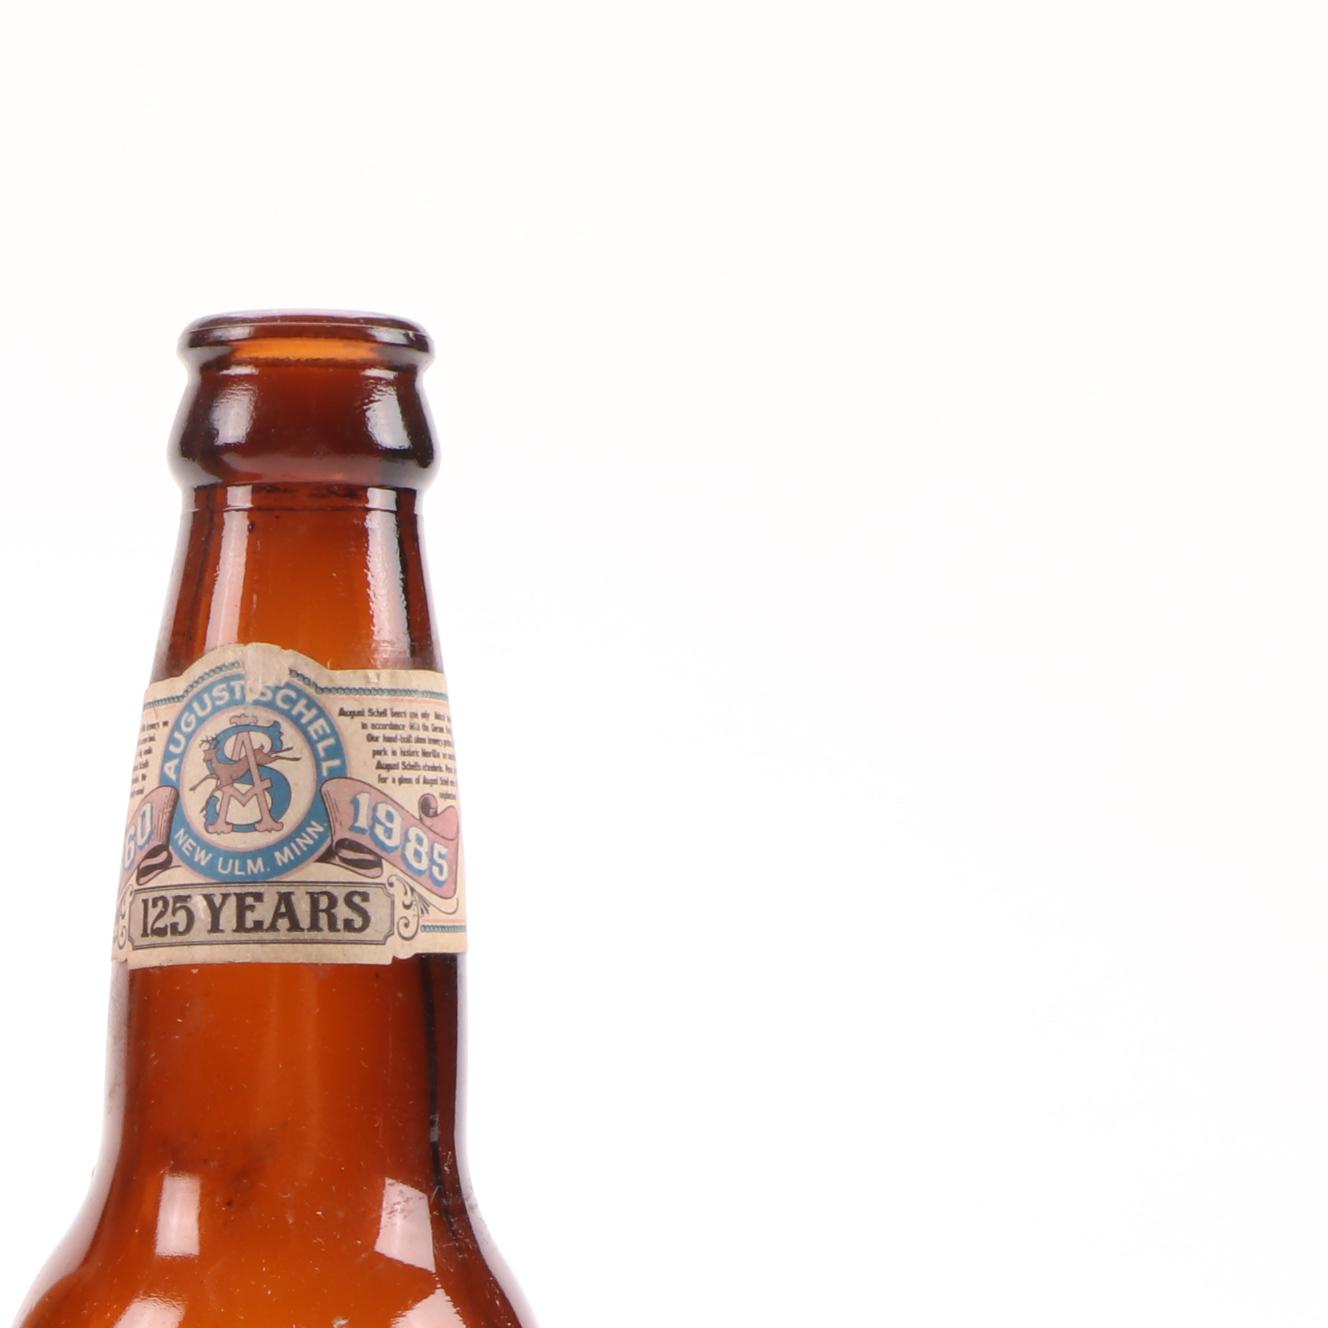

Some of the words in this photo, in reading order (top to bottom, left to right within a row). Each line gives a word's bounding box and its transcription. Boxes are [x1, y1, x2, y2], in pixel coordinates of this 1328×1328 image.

[164, 680, 245, 781] AUGUST
[259, 682, 342, 777] SCHELL
[175, 828, 212, 866] NEW
[274, 820, 328, 866] MINN.
[351, 792, 449, 888] 1985
[140, 896, 196, 938] 125
[200, 889, 372, 935] YEARS
